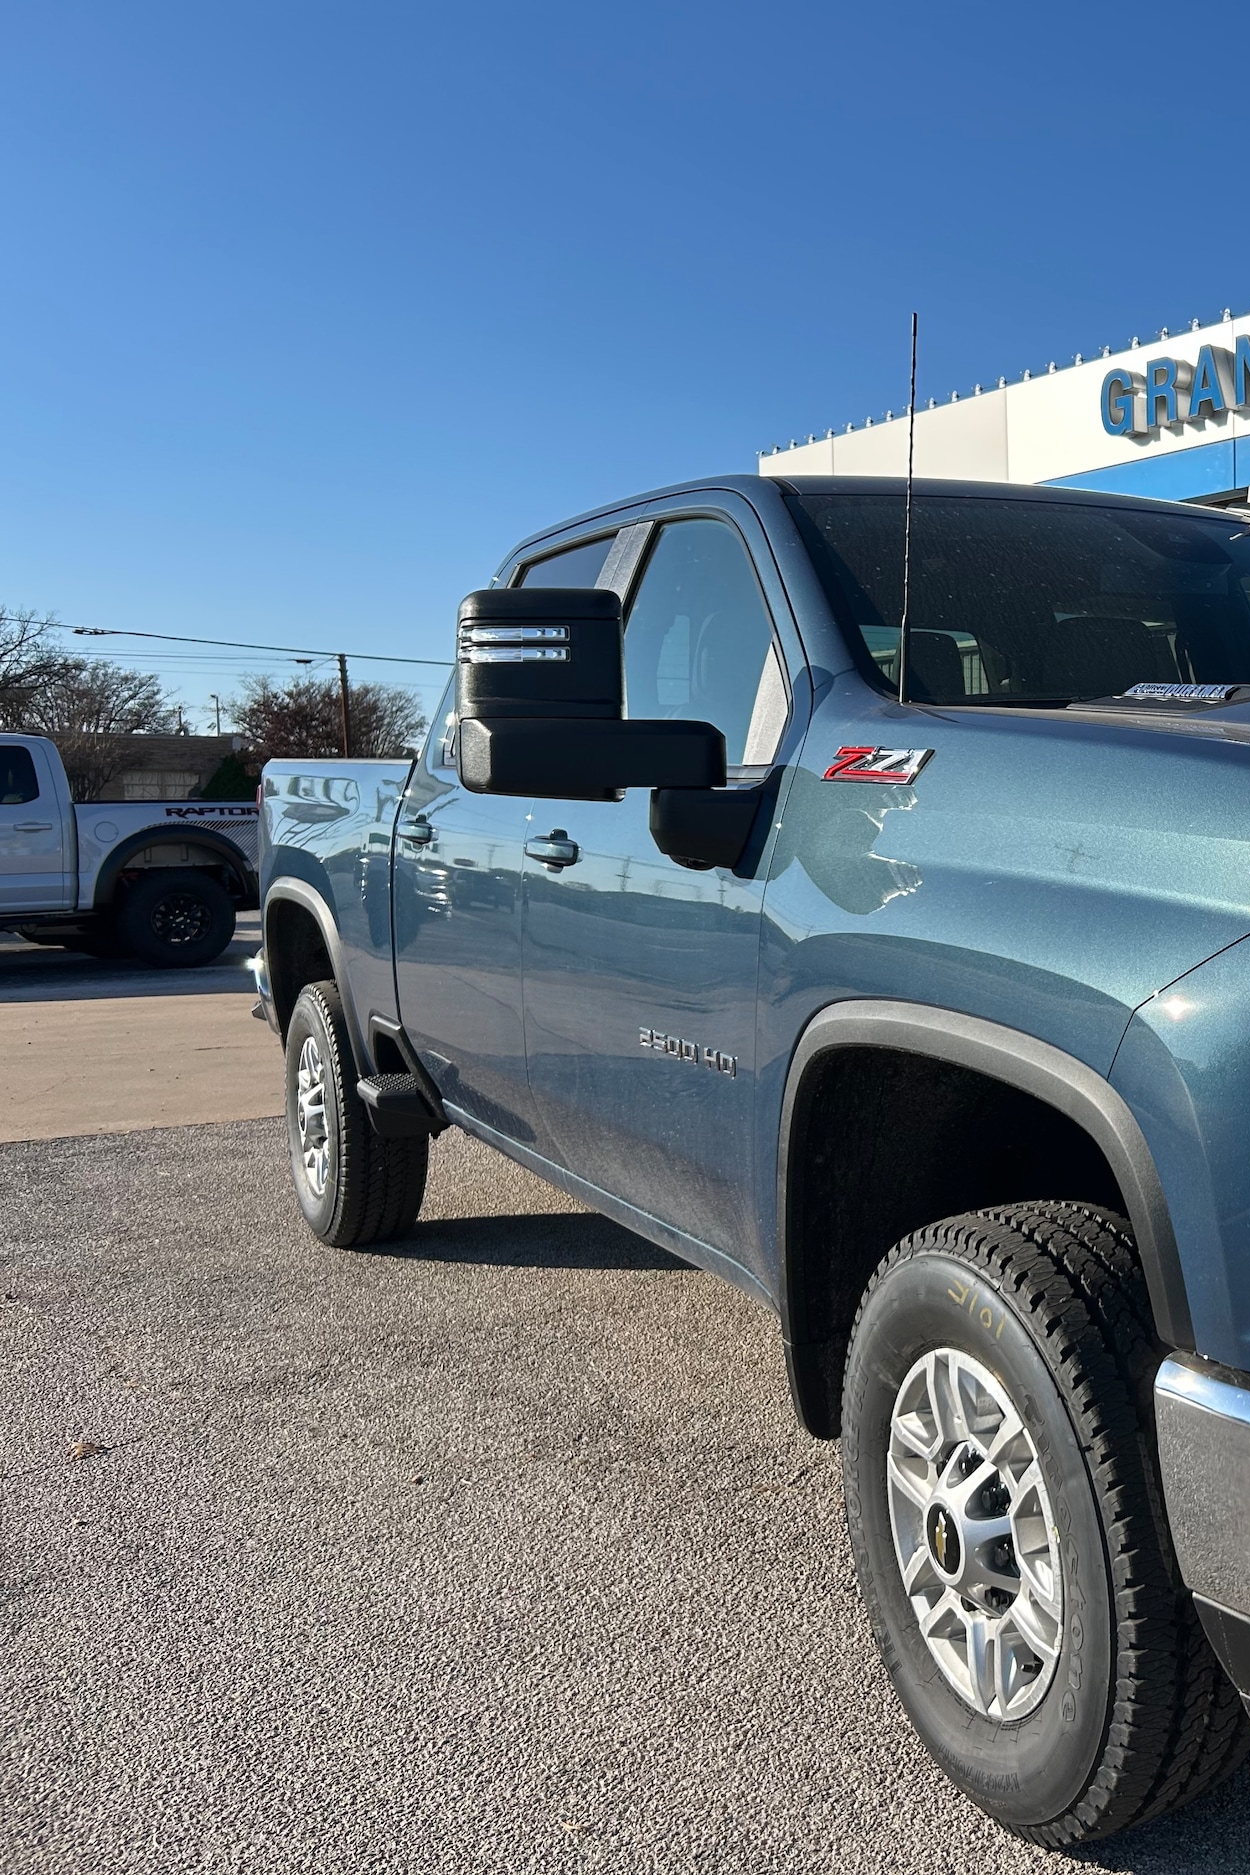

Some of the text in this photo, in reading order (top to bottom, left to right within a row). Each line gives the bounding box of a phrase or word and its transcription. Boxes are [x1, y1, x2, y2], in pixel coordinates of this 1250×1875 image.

[821, 746, 935, 785] Z71
[165, 807, 260, 819] RAPTOR
[639, 1027, 699, 1065] 2500
